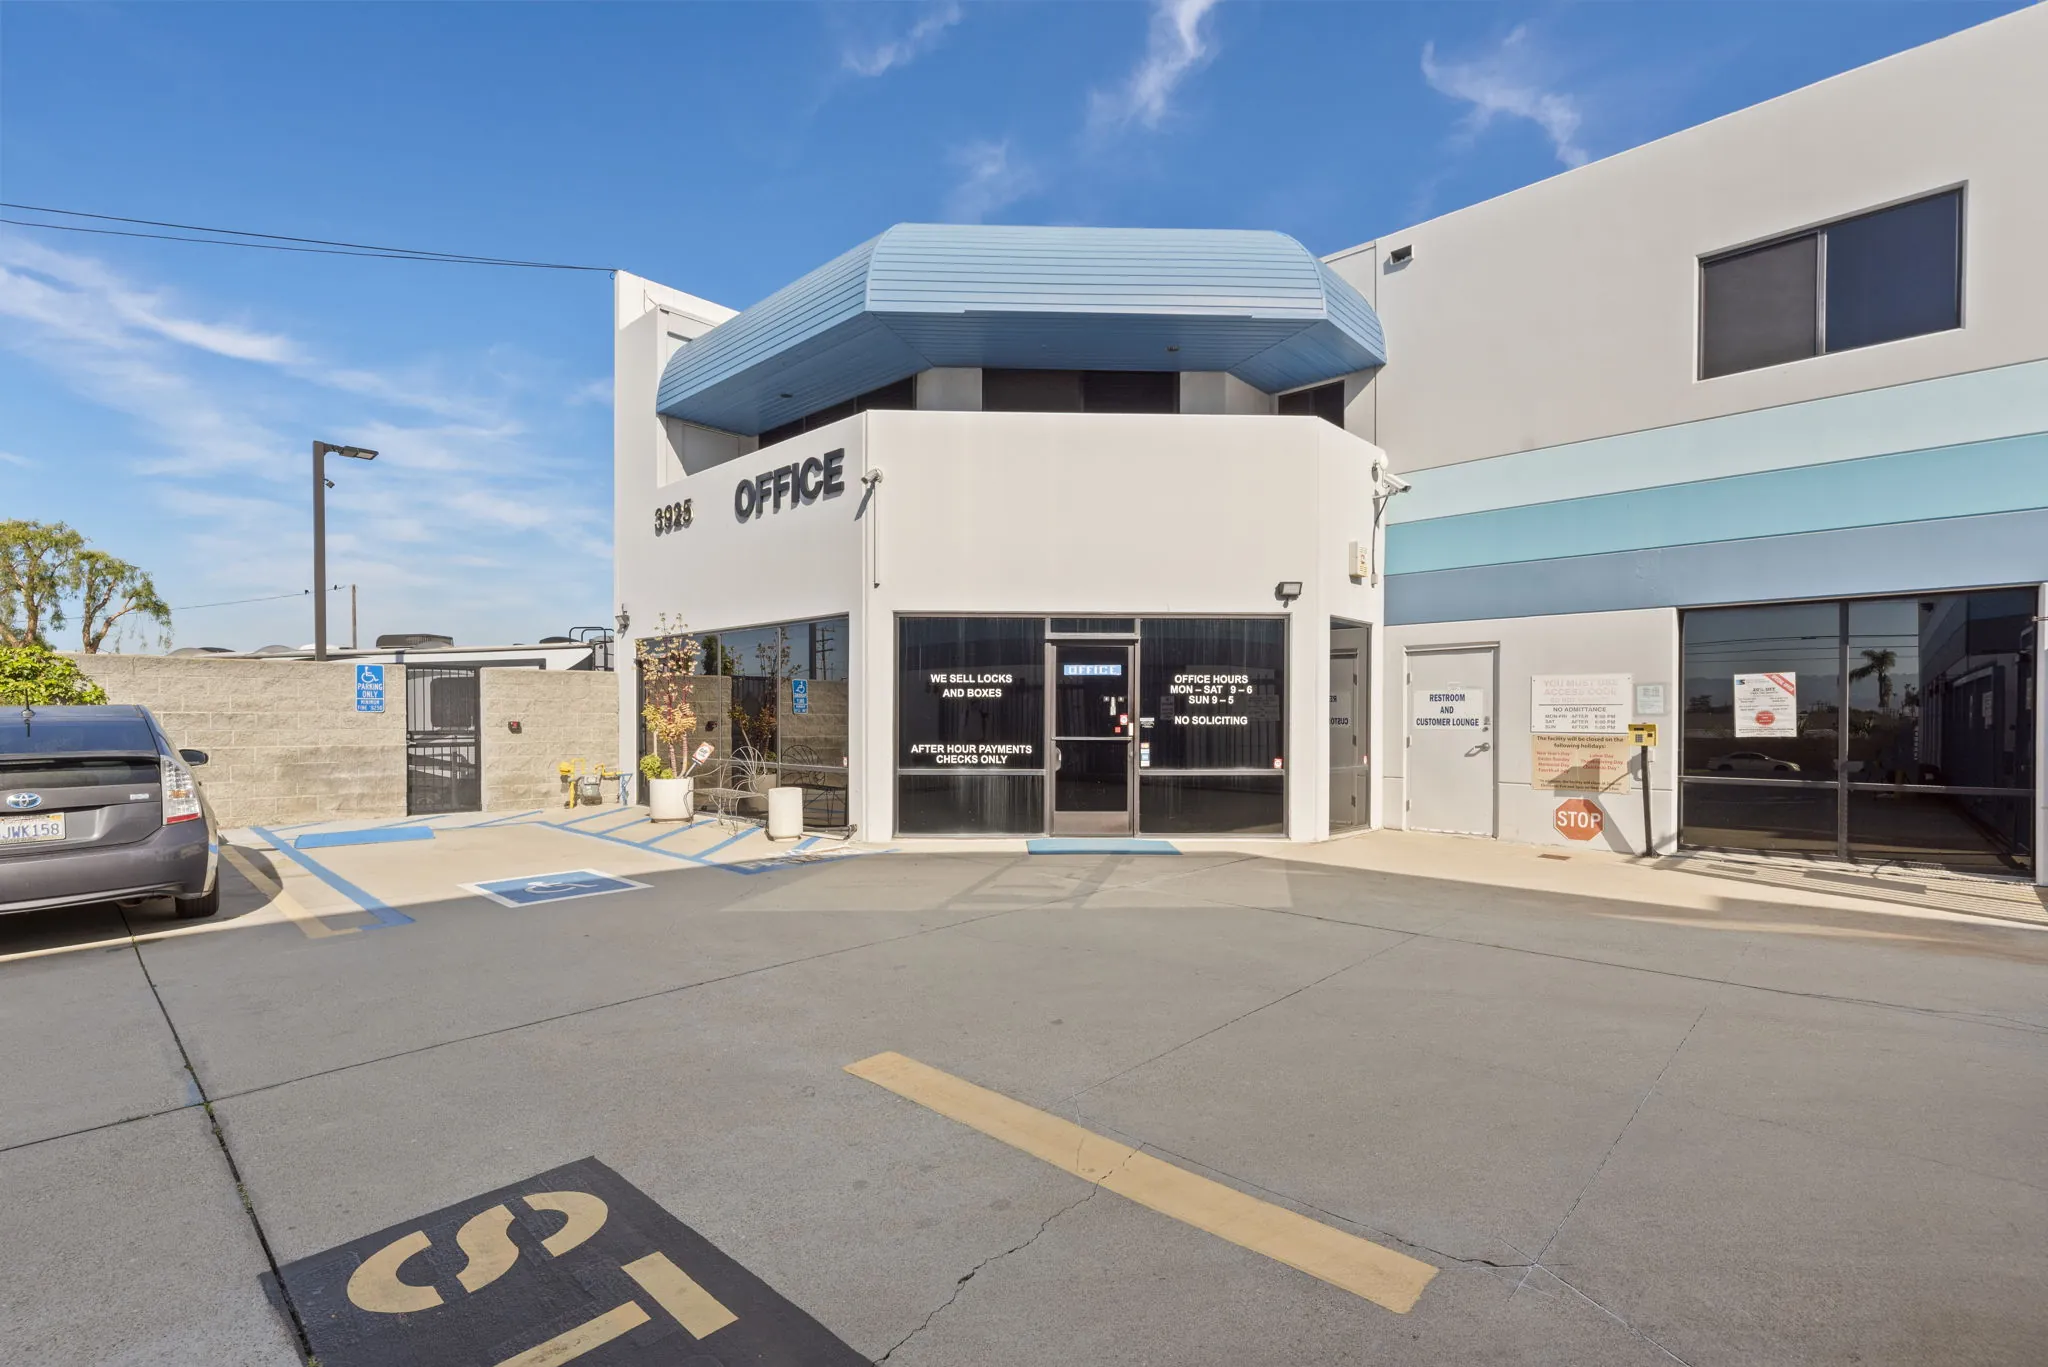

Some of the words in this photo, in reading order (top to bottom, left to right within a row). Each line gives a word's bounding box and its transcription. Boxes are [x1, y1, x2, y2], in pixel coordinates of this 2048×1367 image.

[735, 448, 845, 521] OFFICE
[654, 498, 693, 534] 3925
[1068, 665, 1118, 675] OFFICE
[930, 674, 947, 683] WE
[949, 674, 975, 683] SELL
[977, 674, 1013, 683] LOCKS
[1174, 674, 1211, 684] OFFICE
[1213, 674, 1249, 684] HOURS
[942, 688, 965, 698] AND
[967, 688, 1002, 698] BOXES
[1170, 685, 1193, 694] MON
[1203, 685, 1223, 694] SAT
[1230, 685, 1237, 694] 9
[1246, 685, 1253, 694] 6
[1188, 695, 1210, 704] SUN
[1212, 695, 1217, 704] 9
[1228, 695, 1234, 704] 5
[1429, 694, 1465, 702] RESTROOM
[1440, 706, 1454, 714] AND
[1174, 716, 1190, 725] NO
[1192, 716, 1248, 725] SOLICITING
[1416, 718, 1450, 726] CUSTOMER
[1452, 718, 1479, 726] LOUNGE
[911, 744, 945, 754] AFTER
[947, 744, 977, 754] HOUR
[979, 744, 1033, 754] PAYMENTS
[936, 755, 978, 764] CHECKS
[980, 755, 1008, 764] ONLY
[1557, 810, 1601, 829] STOP
[2, 823, 60, 839] JWK158
